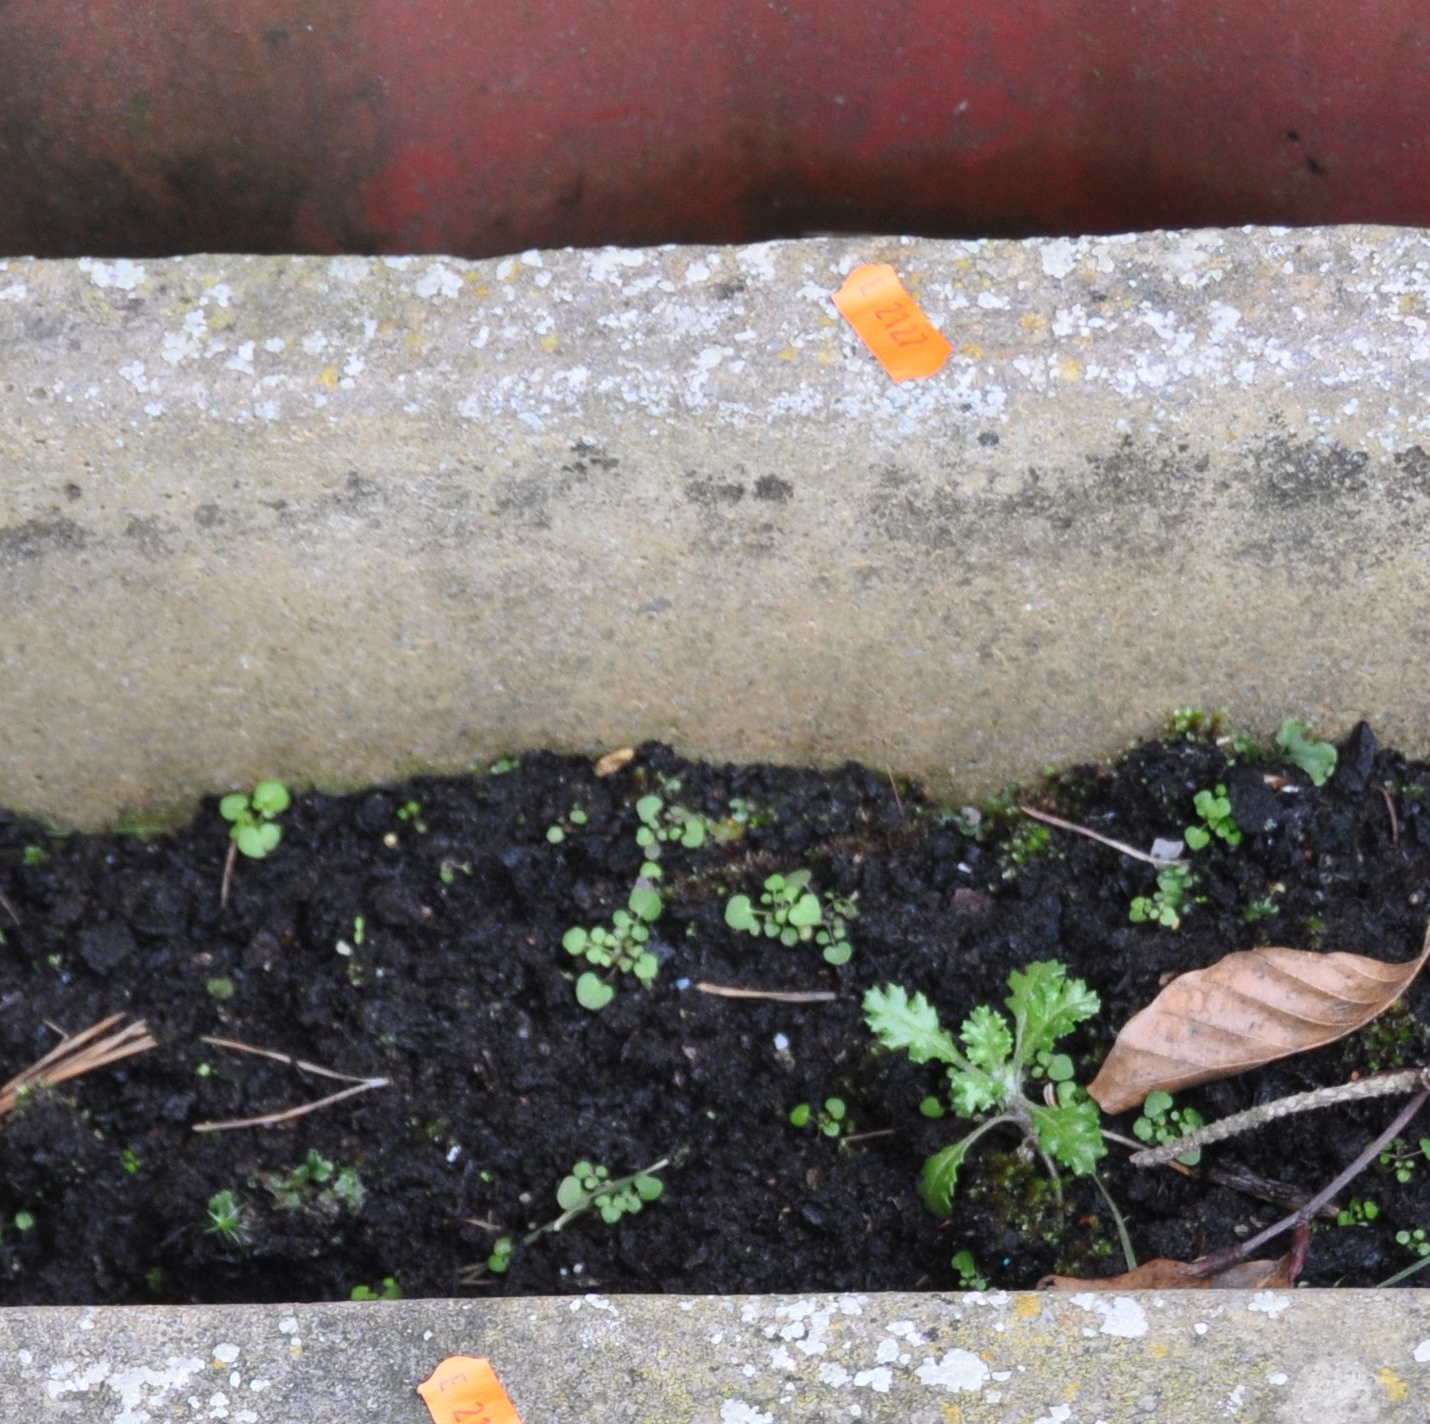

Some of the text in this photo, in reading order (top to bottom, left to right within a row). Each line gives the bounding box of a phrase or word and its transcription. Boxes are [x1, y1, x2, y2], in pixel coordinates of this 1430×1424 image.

[861, 277, 928, 346] E 2127
[439, 1374, 468, 1392] E
